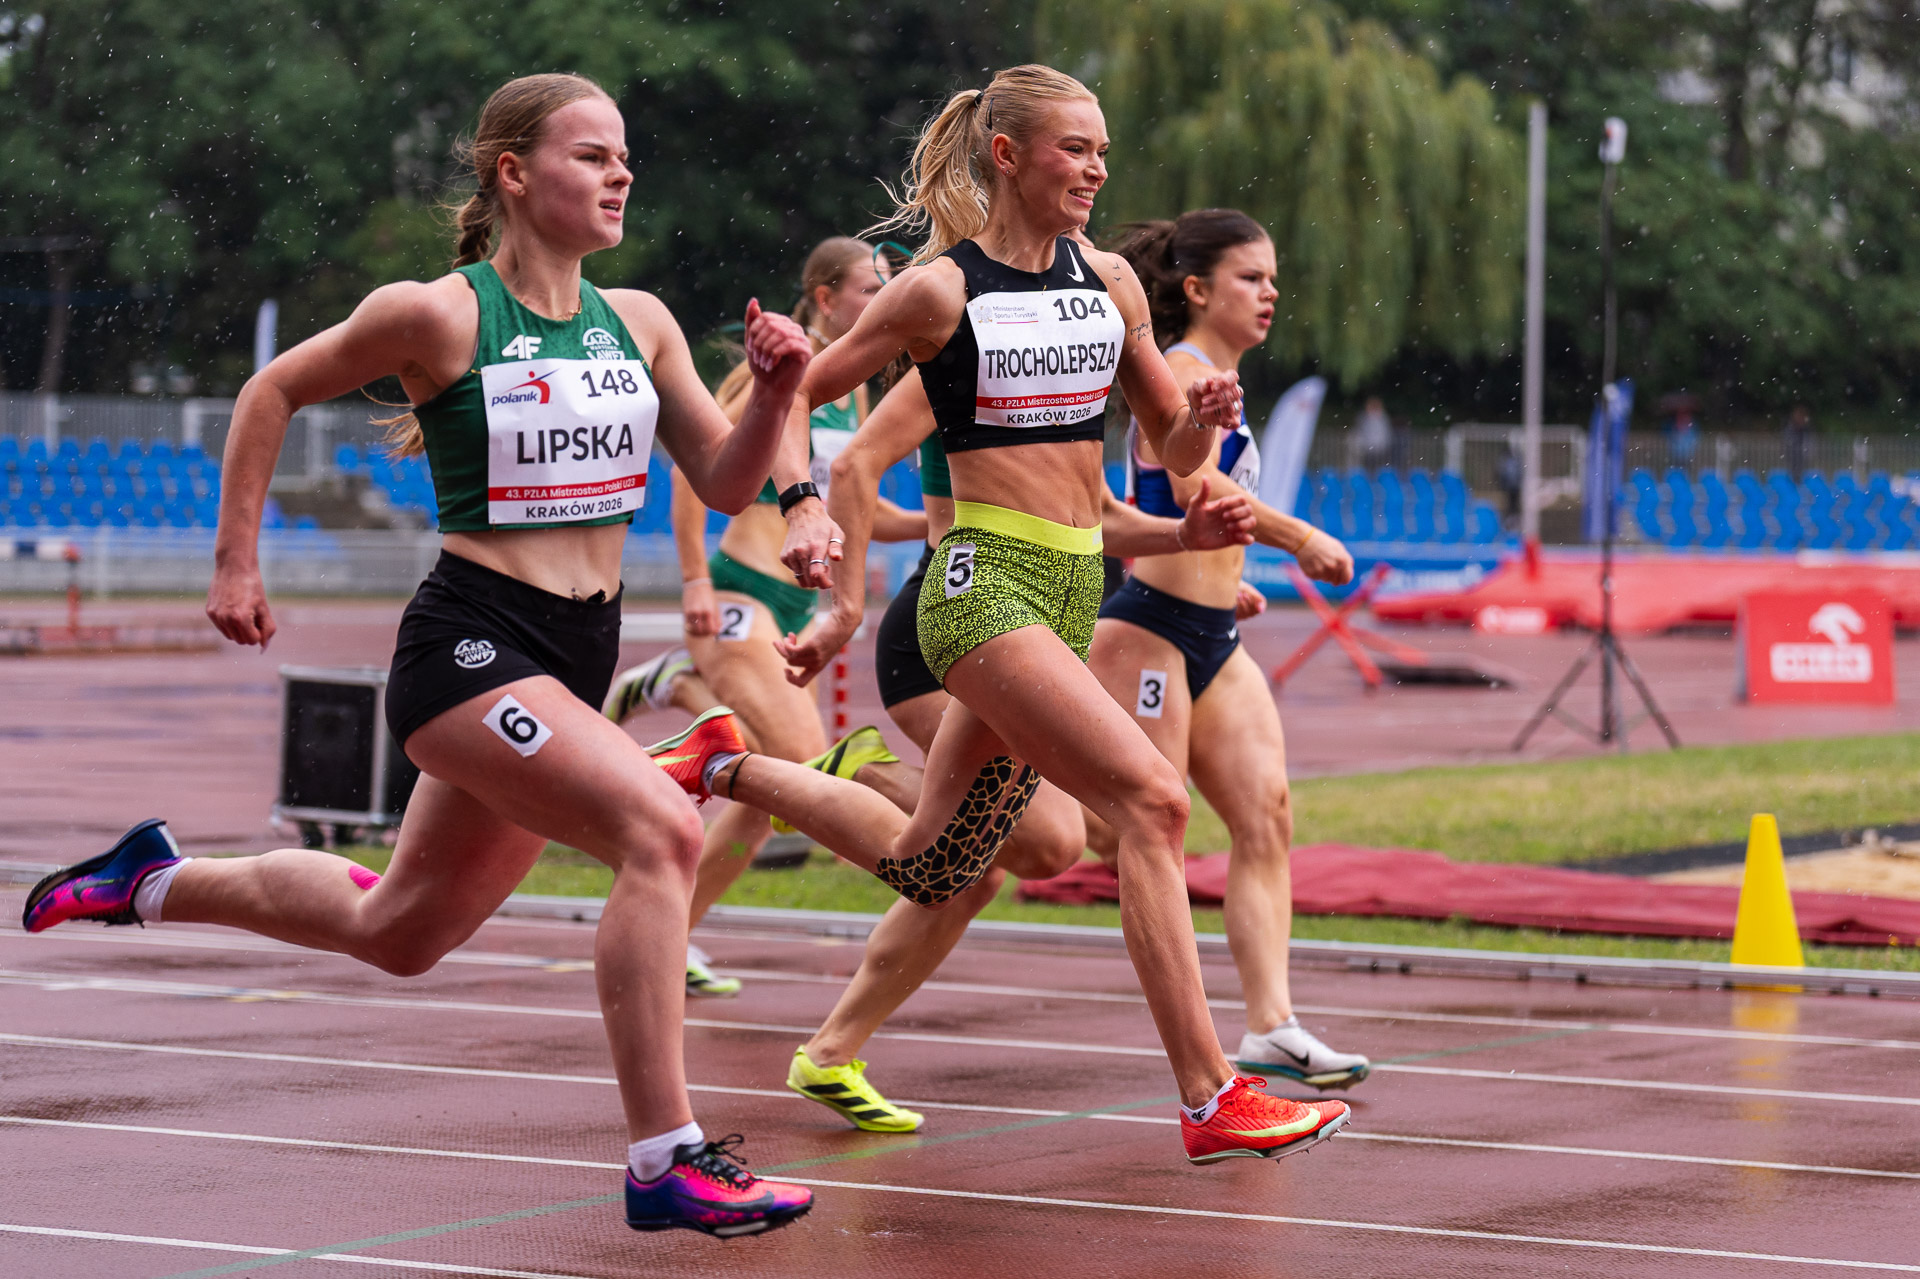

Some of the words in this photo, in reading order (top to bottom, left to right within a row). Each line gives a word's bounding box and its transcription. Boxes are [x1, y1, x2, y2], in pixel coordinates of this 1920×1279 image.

[1014, 311, 1038, 319] Turystyki
[1053, 296, 1106, 322] 104
[501, 334, 542, 360] 4F
[985, 341, 1116, 379] TROCHOLEPSZA
[581, 368, 639, 398] 148
[491, 390, 538, 407] polanik
[991, 399, 1005, 408] 43.
[1006, 398, 1026, 408] PZLA
[1027, 395, 1075, 406] Mistrzostwa
[1076, 392, 1094, 403] Polski
[1094, 389, 1105, 400] U23
[1007, 408, 1066, 424] KRAKÓW
[1070, 406, 1092, 421] 2026
[517, 423, 634, 464] LIPSKA
[505, 488, 522, 499] 43.
[523, 487, 548, 499] PZLA
[550, 485, 603, 498] Mistrzostwa
[604, 482, 623, 493] Polski
[623, 477, 636, 488] U23
[525, 500, 595, 519] KRAKÓW
[598, 497, 622, 512] 2026
[948, 552, 971, 587] 5
[719, 607, 744, 637] 2
[1142, 679, 1161, 708] 3
[499, 706, 538, 745] 6
